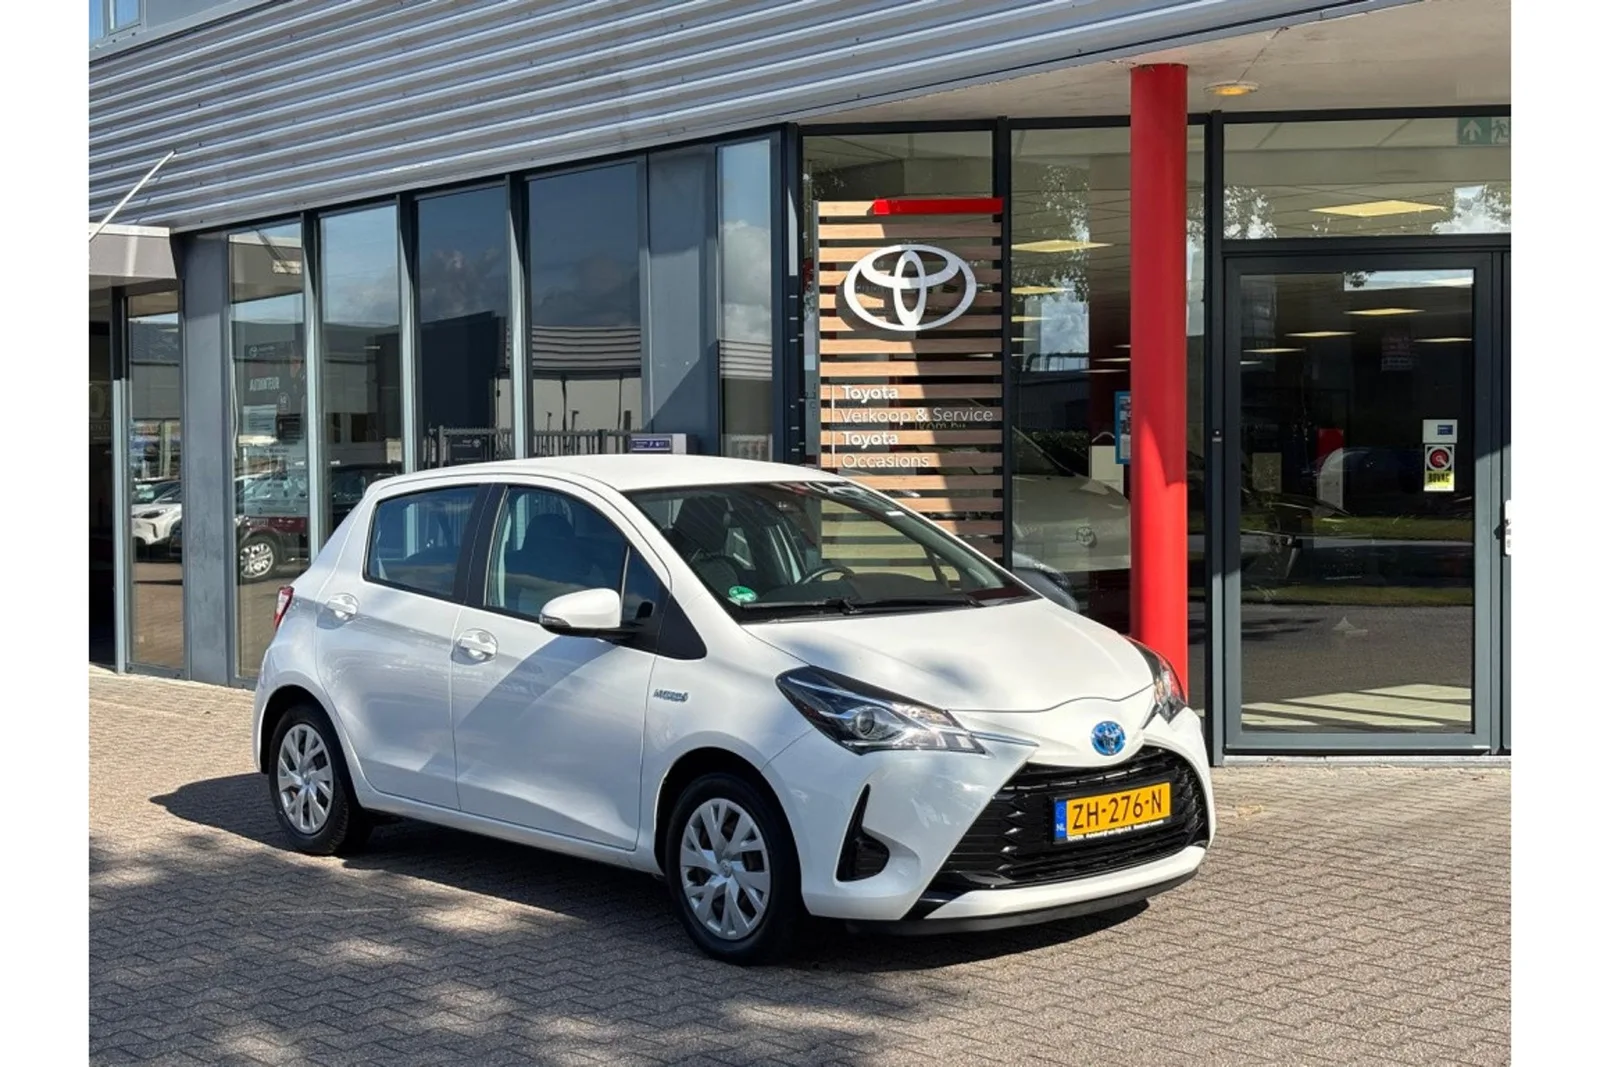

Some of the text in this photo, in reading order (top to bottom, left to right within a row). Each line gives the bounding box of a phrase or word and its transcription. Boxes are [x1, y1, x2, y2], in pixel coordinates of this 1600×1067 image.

[841, 384, 898, 403] Toyota
[840, 407, 993, 425] Verkoop & Service
[841, 431, 898, 449] Toyota
[841, 453, 929, 468] Occasions
[1072, 788, 1162, 830] ZH-276-N
